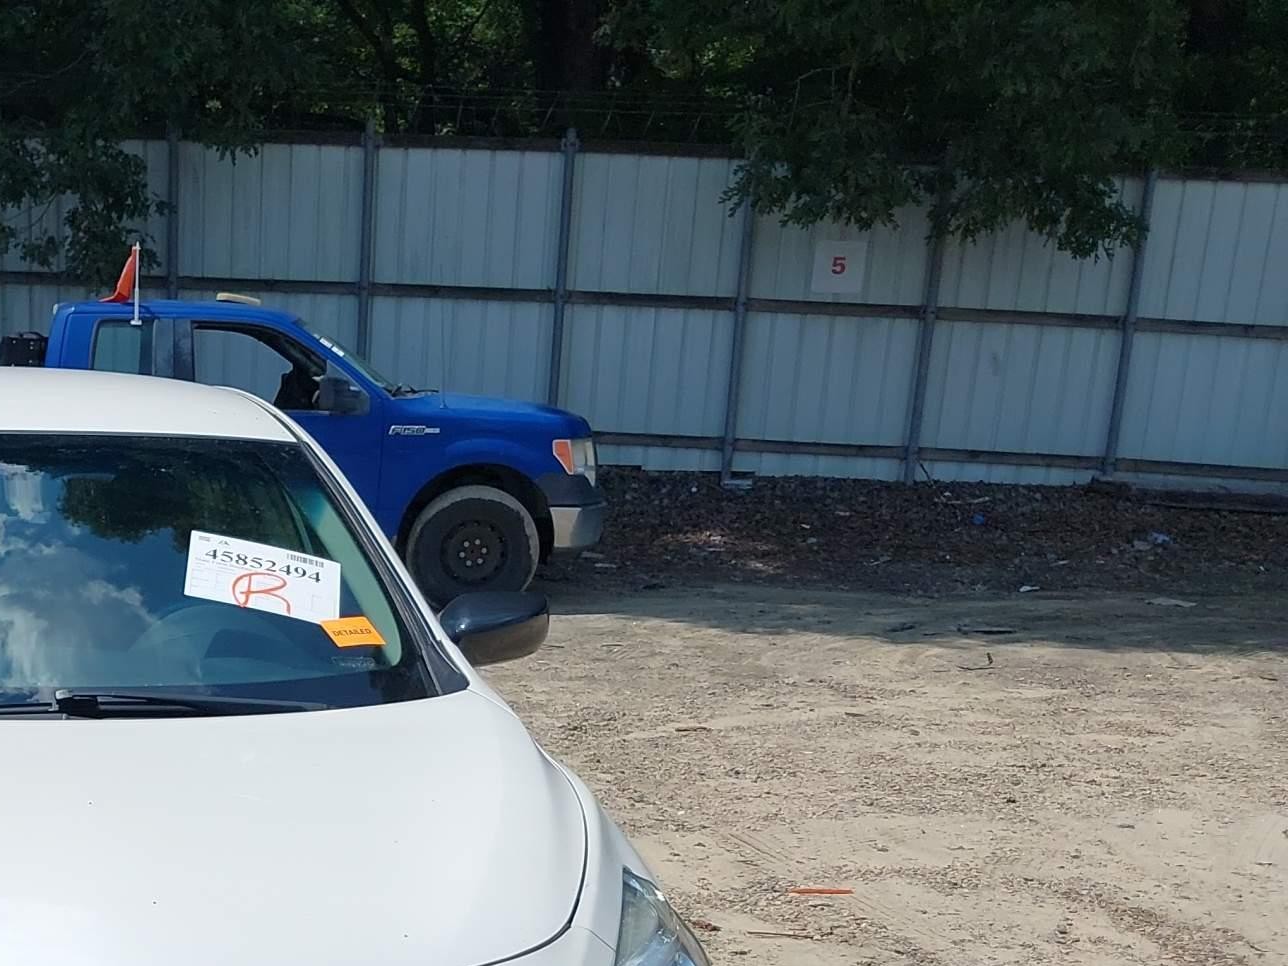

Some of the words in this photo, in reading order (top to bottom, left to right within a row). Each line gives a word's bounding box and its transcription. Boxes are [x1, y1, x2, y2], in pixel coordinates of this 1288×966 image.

[831, 256, 847, 275] 5
[204, 548, 322, 584] 45852494
[332, 628, 373, 637] DETAILED
